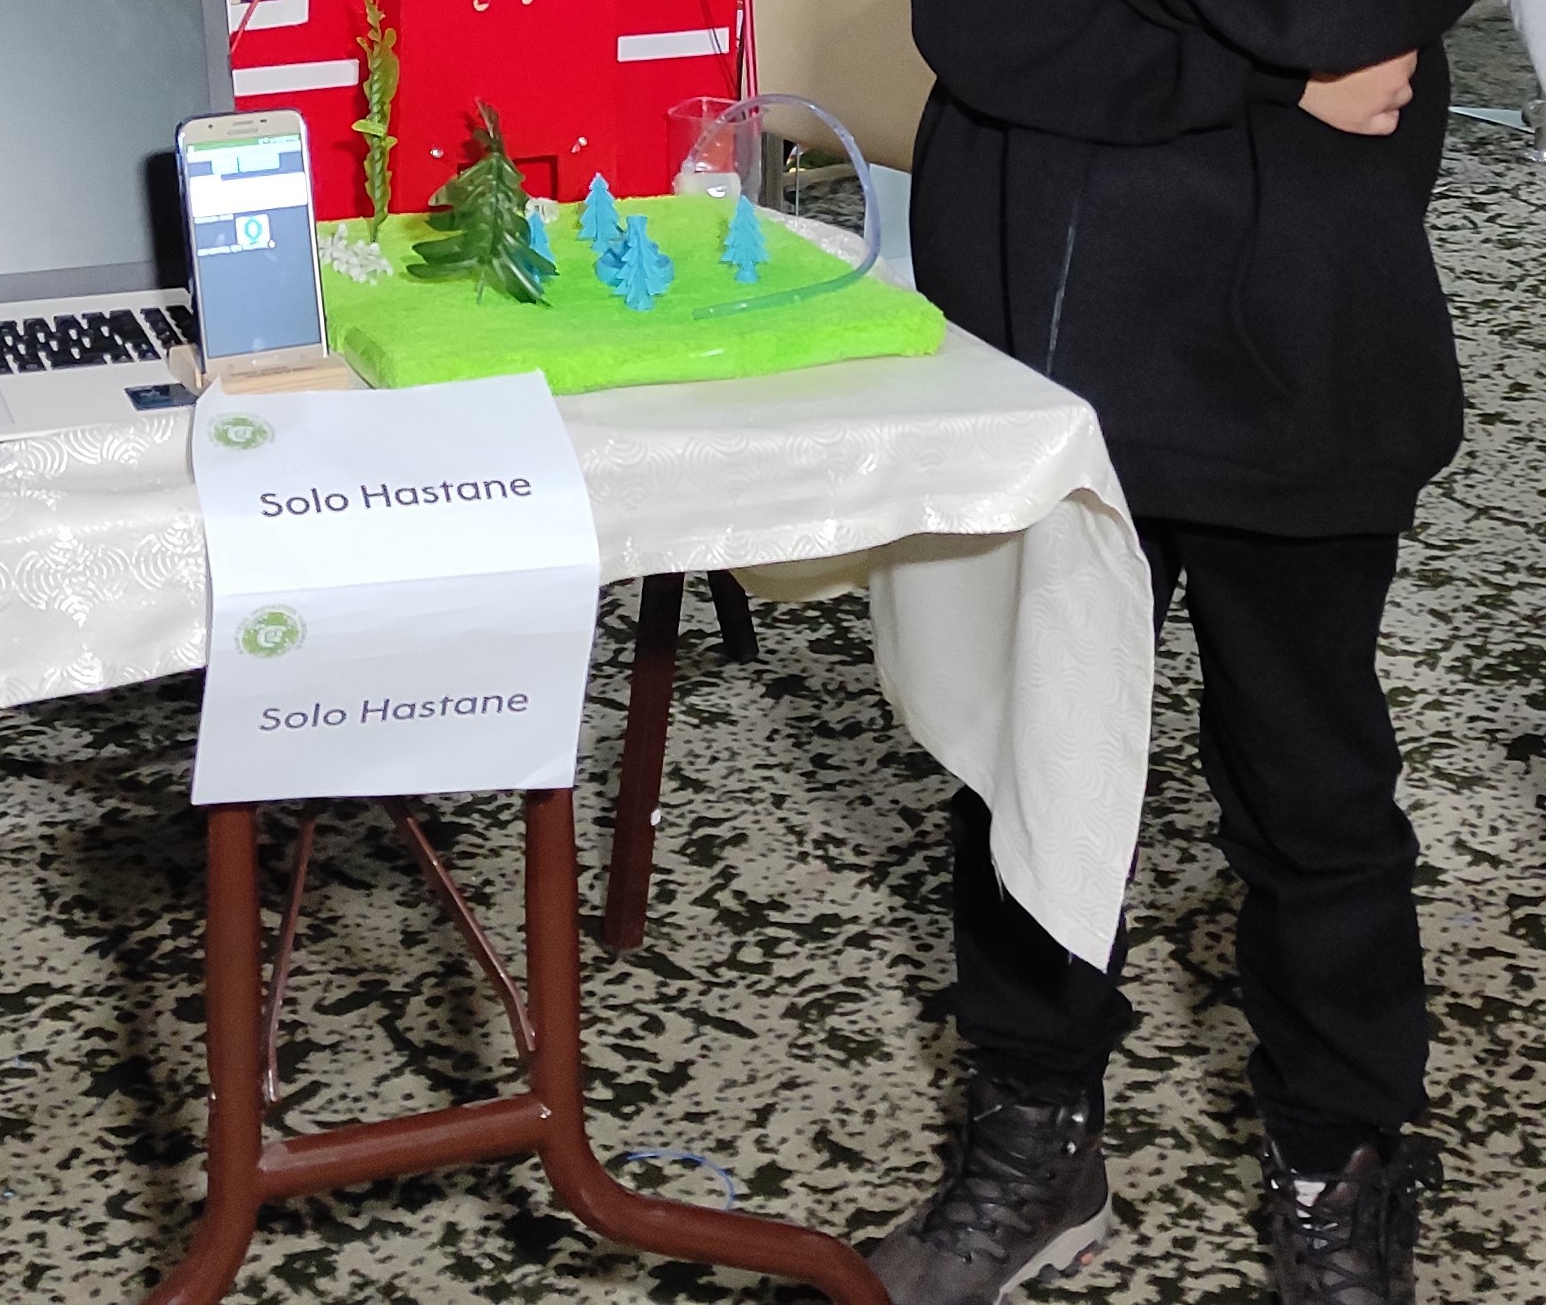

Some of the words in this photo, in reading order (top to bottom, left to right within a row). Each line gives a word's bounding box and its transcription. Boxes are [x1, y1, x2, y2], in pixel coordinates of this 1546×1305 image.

[260, 487, 349, 517] Solo
[360, 478, 532, 510] Hastane
[259, 702, 347, 731] Solo
[360, 693, 530, 724] Hastane
